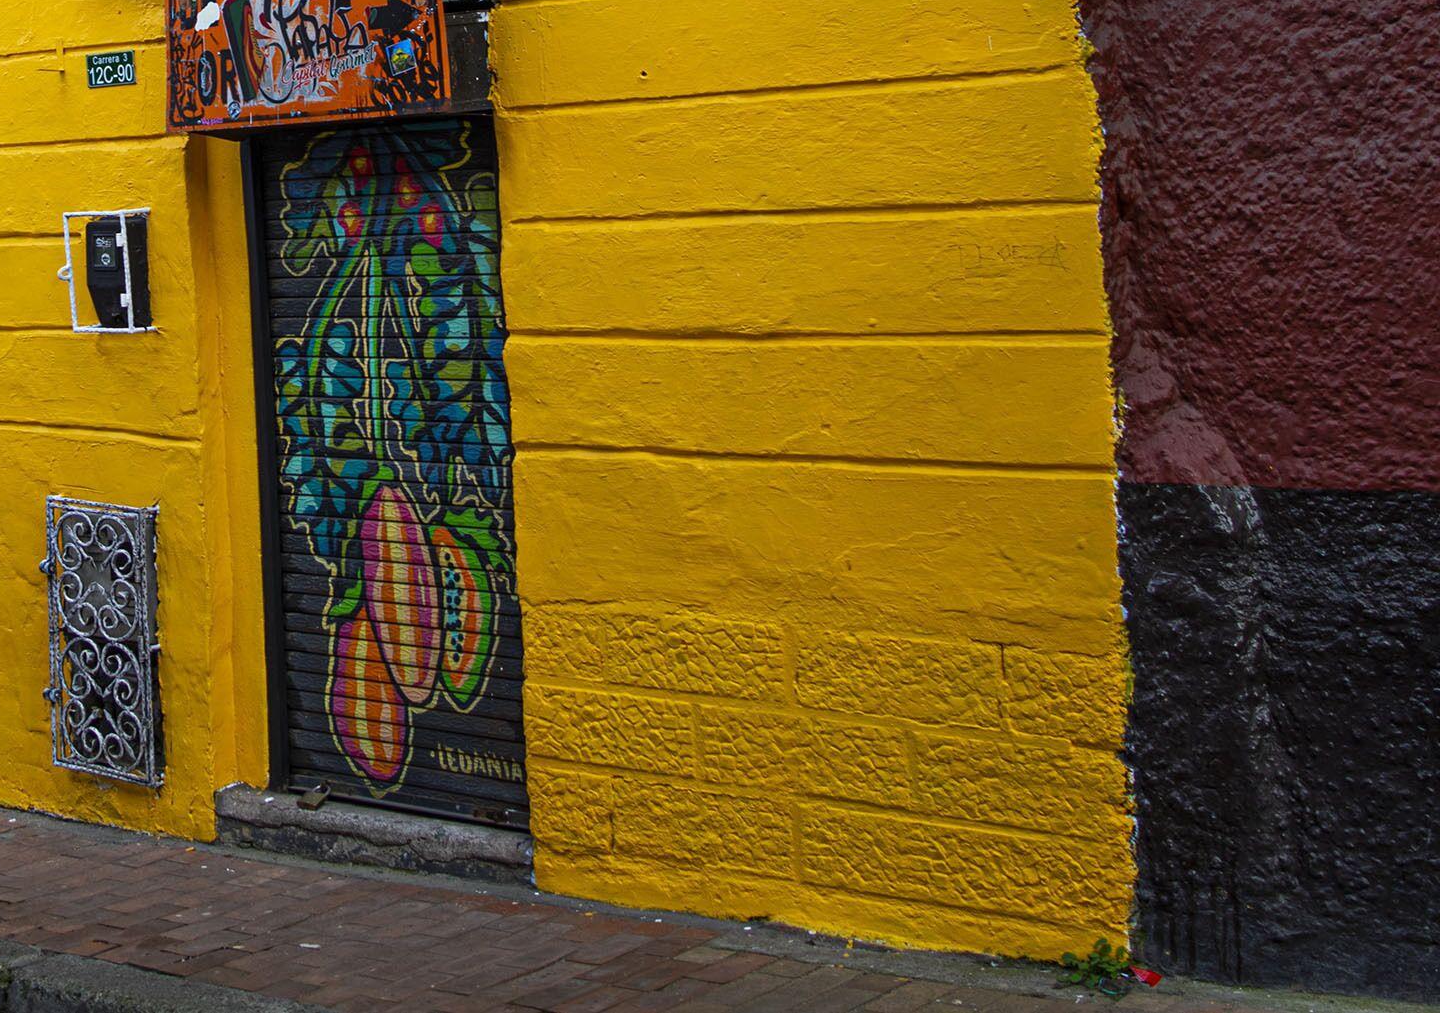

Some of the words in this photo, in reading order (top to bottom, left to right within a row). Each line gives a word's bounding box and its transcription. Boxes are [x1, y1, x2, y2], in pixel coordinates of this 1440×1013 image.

[92, 56, 120, 65] Carrera
[122, 52, 128, 62] 3
[90, 63, 133, 85] 12C-90
